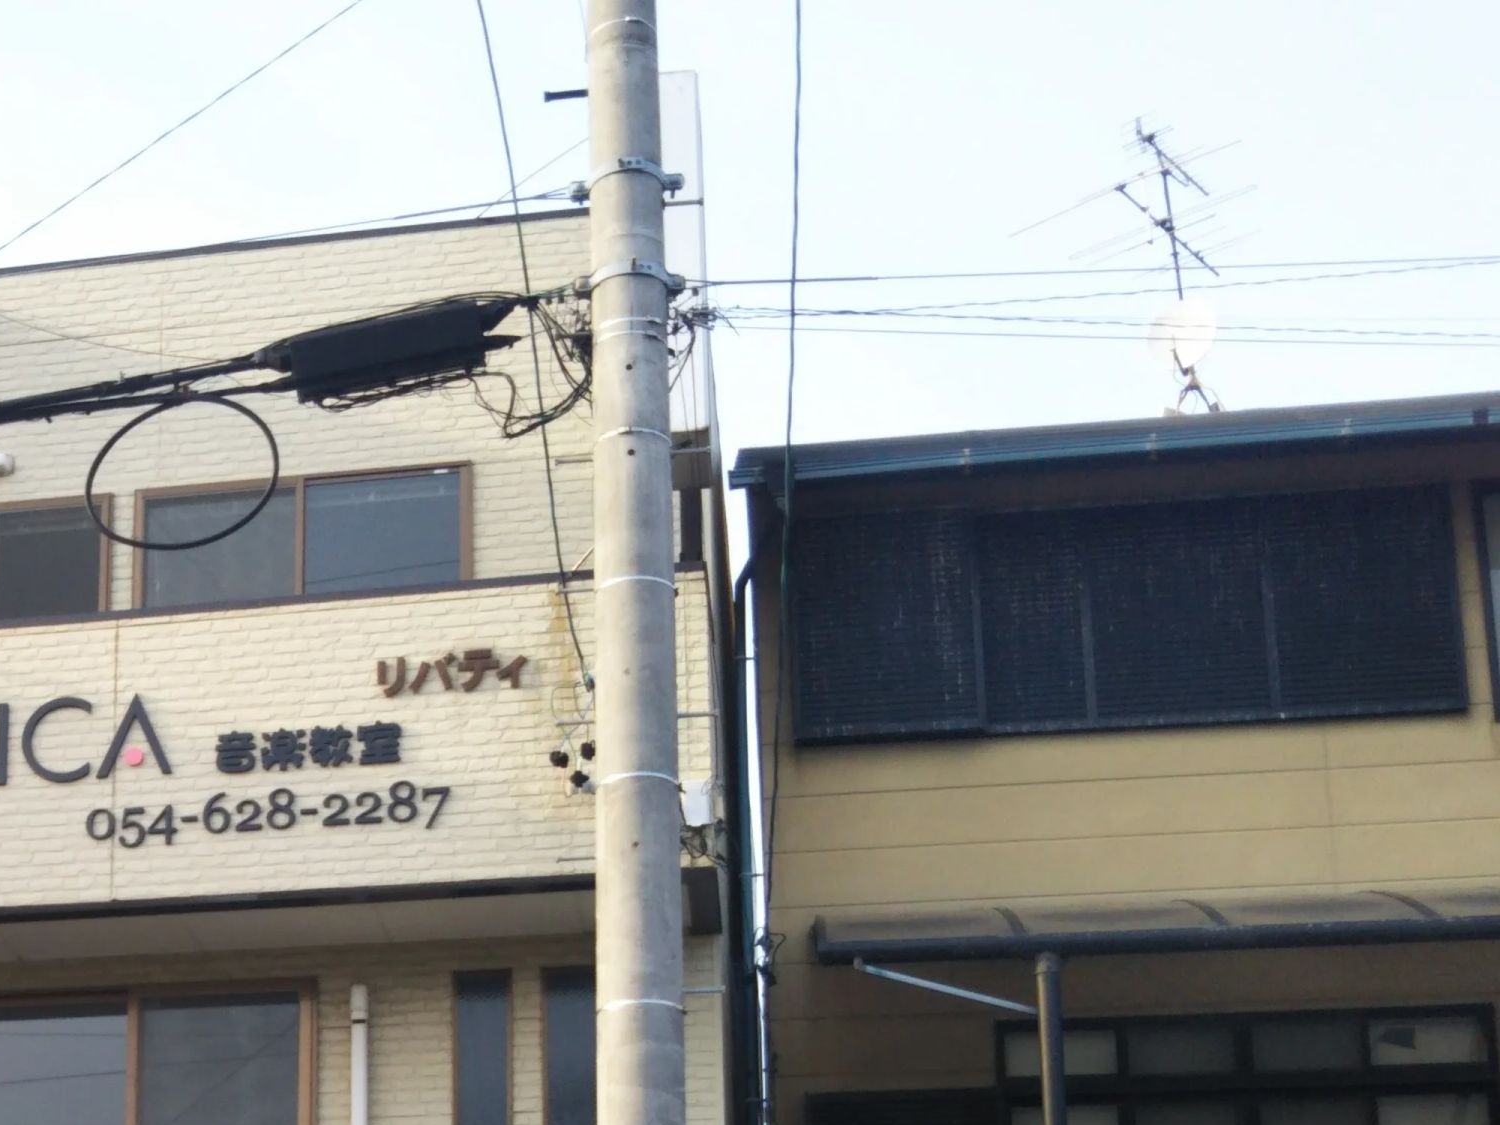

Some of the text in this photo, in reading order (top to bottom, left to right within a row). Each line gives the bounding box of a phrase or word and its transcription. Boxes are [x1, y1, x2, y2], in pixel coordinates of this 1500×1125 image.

[377, 648, 528, 698] リバティ
[215, 720, 403, 774] 音楽教室
[86, 780, 451, 848] 054-628-2287
